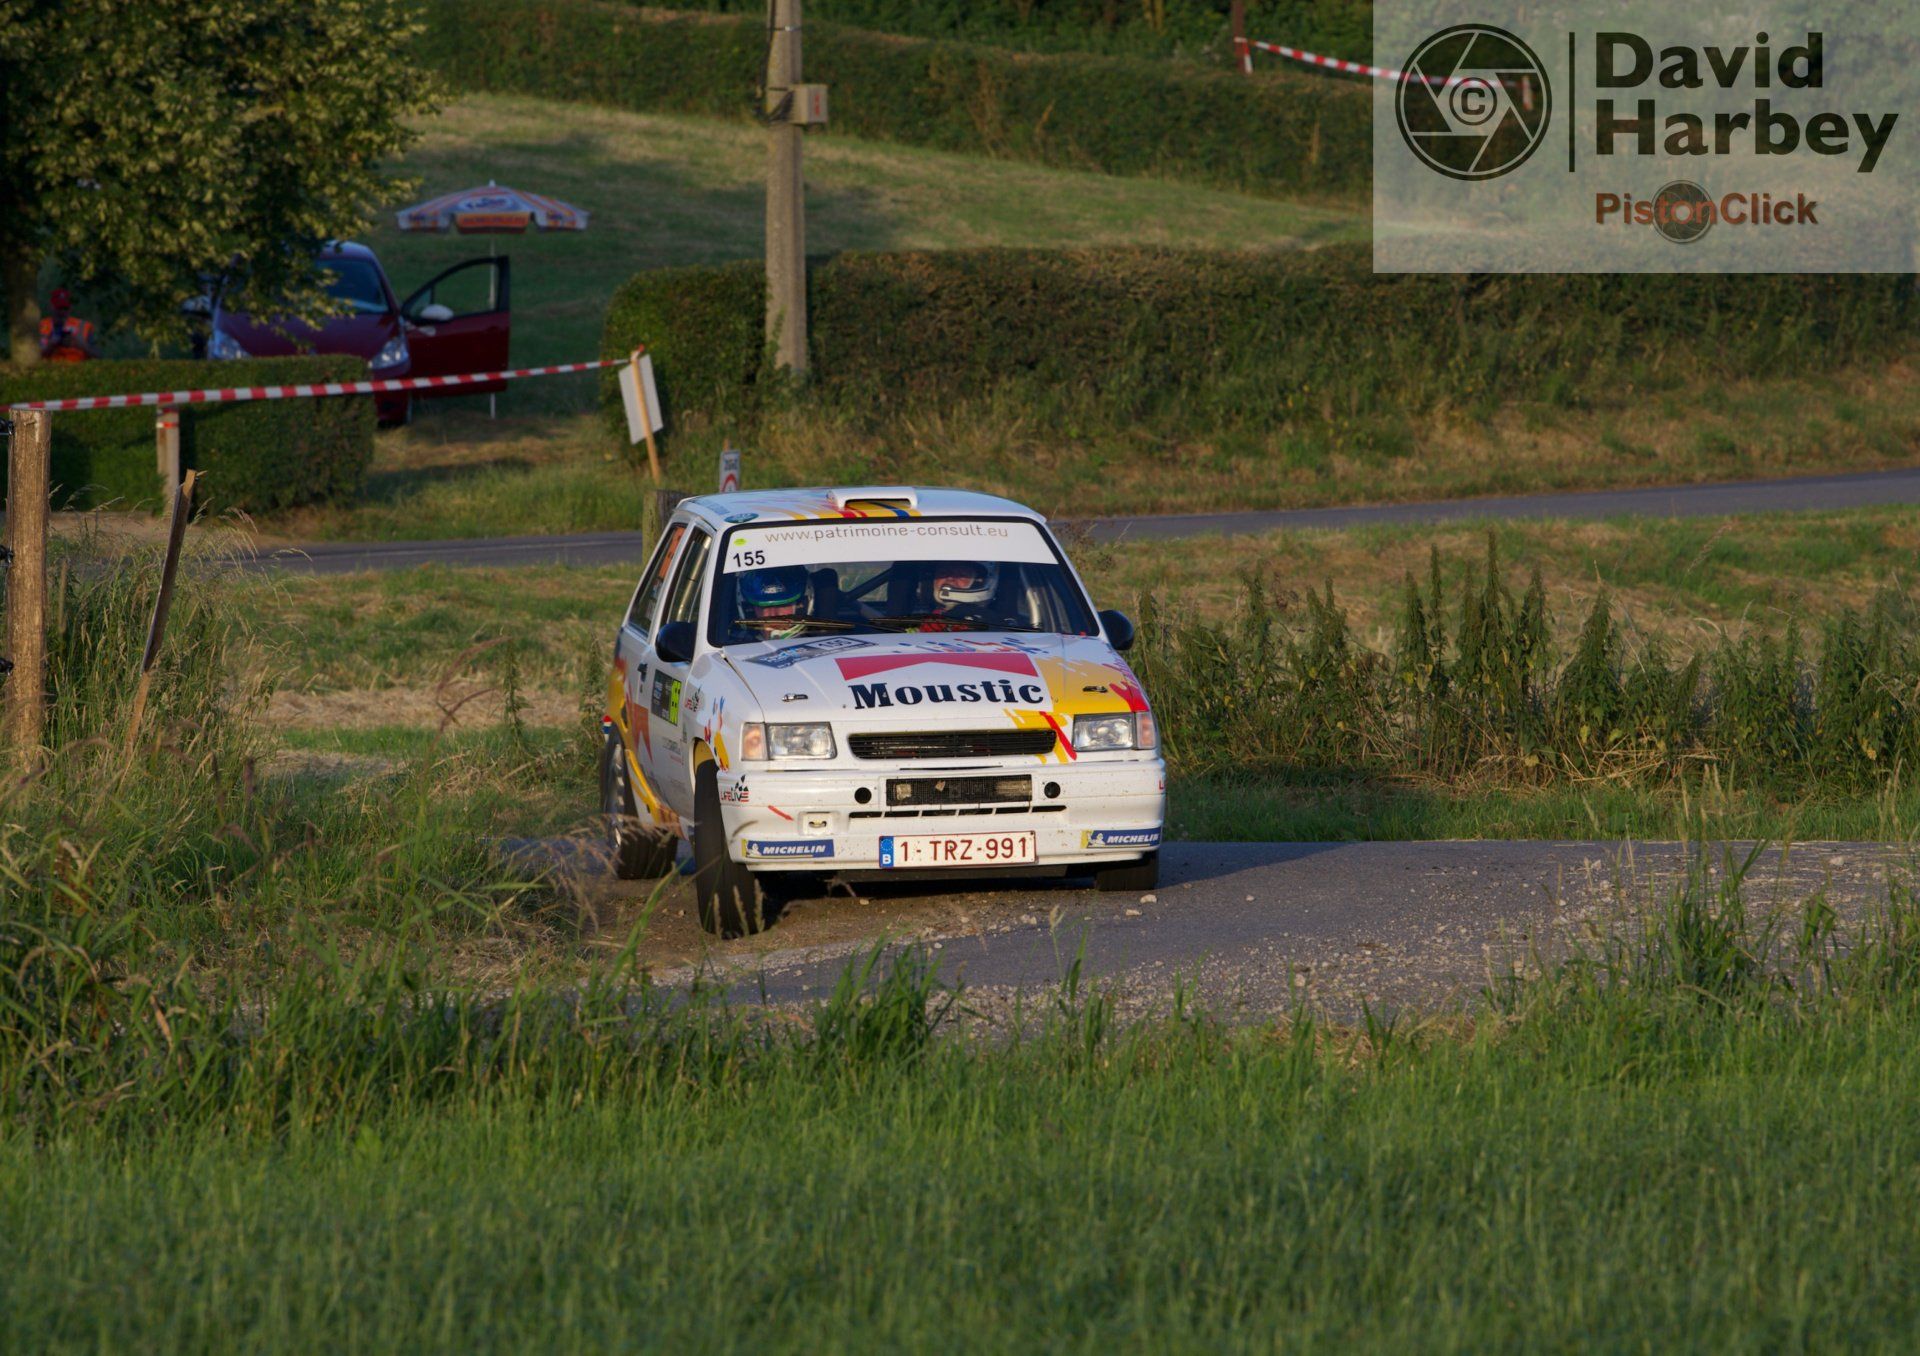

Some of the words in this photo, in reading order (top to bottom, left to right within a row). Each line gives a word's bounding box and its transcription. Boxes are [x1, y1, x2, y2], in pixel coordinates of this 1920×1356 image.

[764, 524, 1009, 543] www.patrimoine-consult.eu
[733, 550, 766, 568] 155
[848, 679, 1044, 709] Moustic
[1106, 833, 1159, 844] MICHELIN
[762, 844, 826, 855] MICHELIN
[882, 853, 892, 865] B
